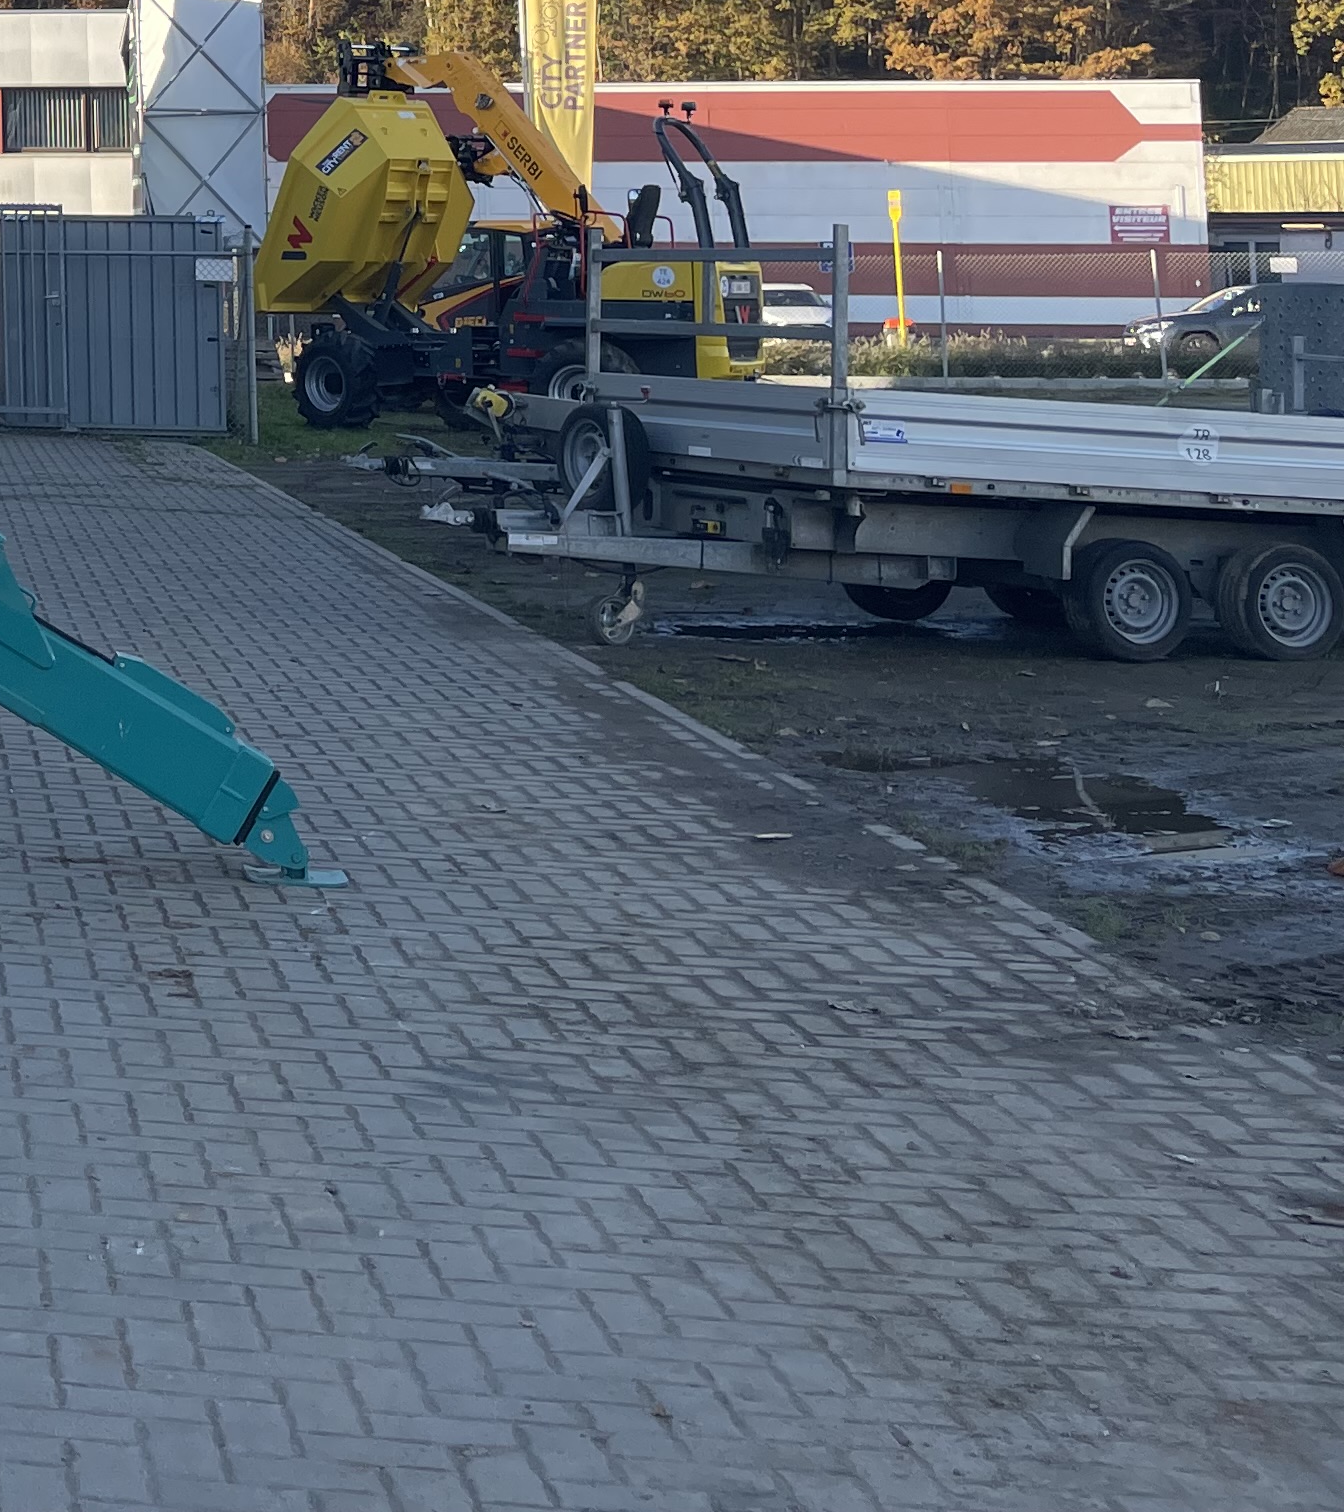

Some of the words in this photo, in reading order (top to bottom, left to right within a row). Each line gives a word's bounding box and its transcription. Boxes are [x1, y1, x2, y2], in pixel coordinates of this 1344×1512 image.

[541, 53, 562, 109] CITY
[564, 1, 587, 111] PARTNER
[507, 136, 544, 181] SERBI
[1186, 448, 1212, 460] 128
